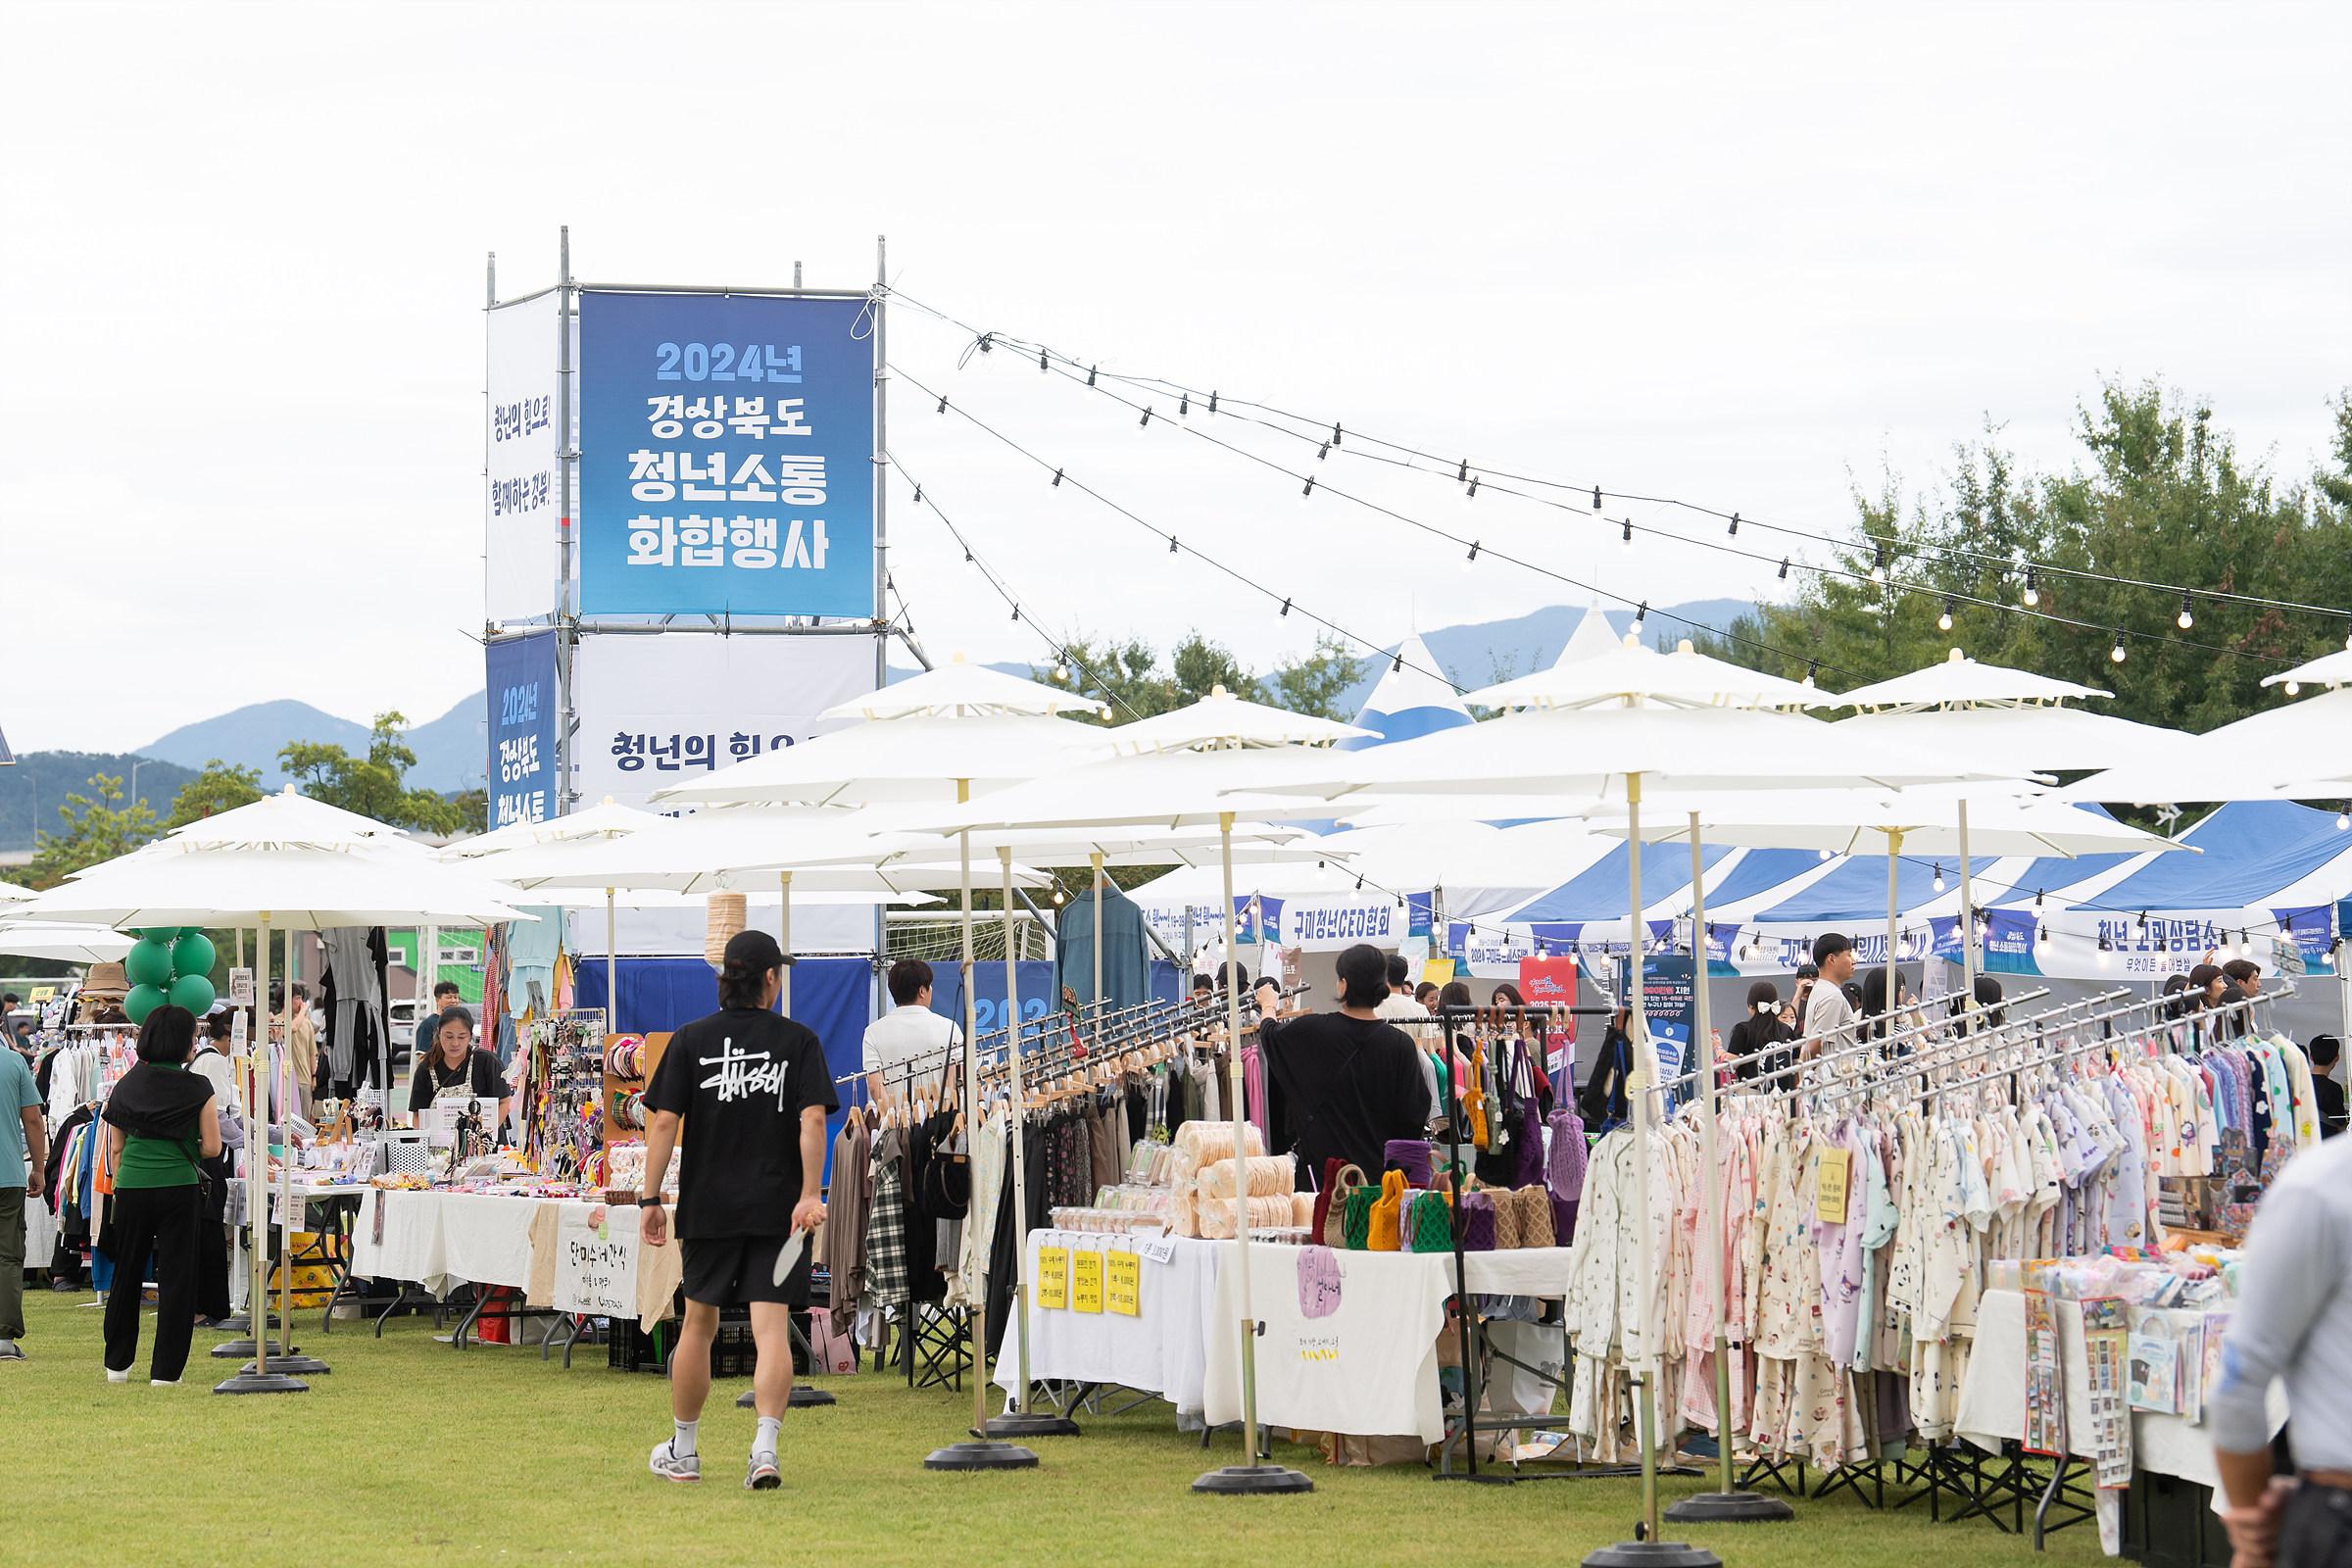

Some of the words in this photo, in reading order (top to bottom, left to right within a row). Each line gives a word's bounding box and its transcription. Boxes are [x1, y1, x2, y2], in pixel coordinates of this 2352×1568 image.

[656, 342, 803, 384] 2024년
[647, 394, 812, 440] 경상북도
[627, 448, 827, 506] 청년소통
[626, 514, 830, 569] 화합행사
[501, 681, 538, 726] 2024년
[499, 733, 541, 783] 경상북도
[611, 731, 715, 771] 청년의
[1294, 906, 1392, 940] 구미청년CEO협회
[2126, 957, 2156, 972] 무엇이든
